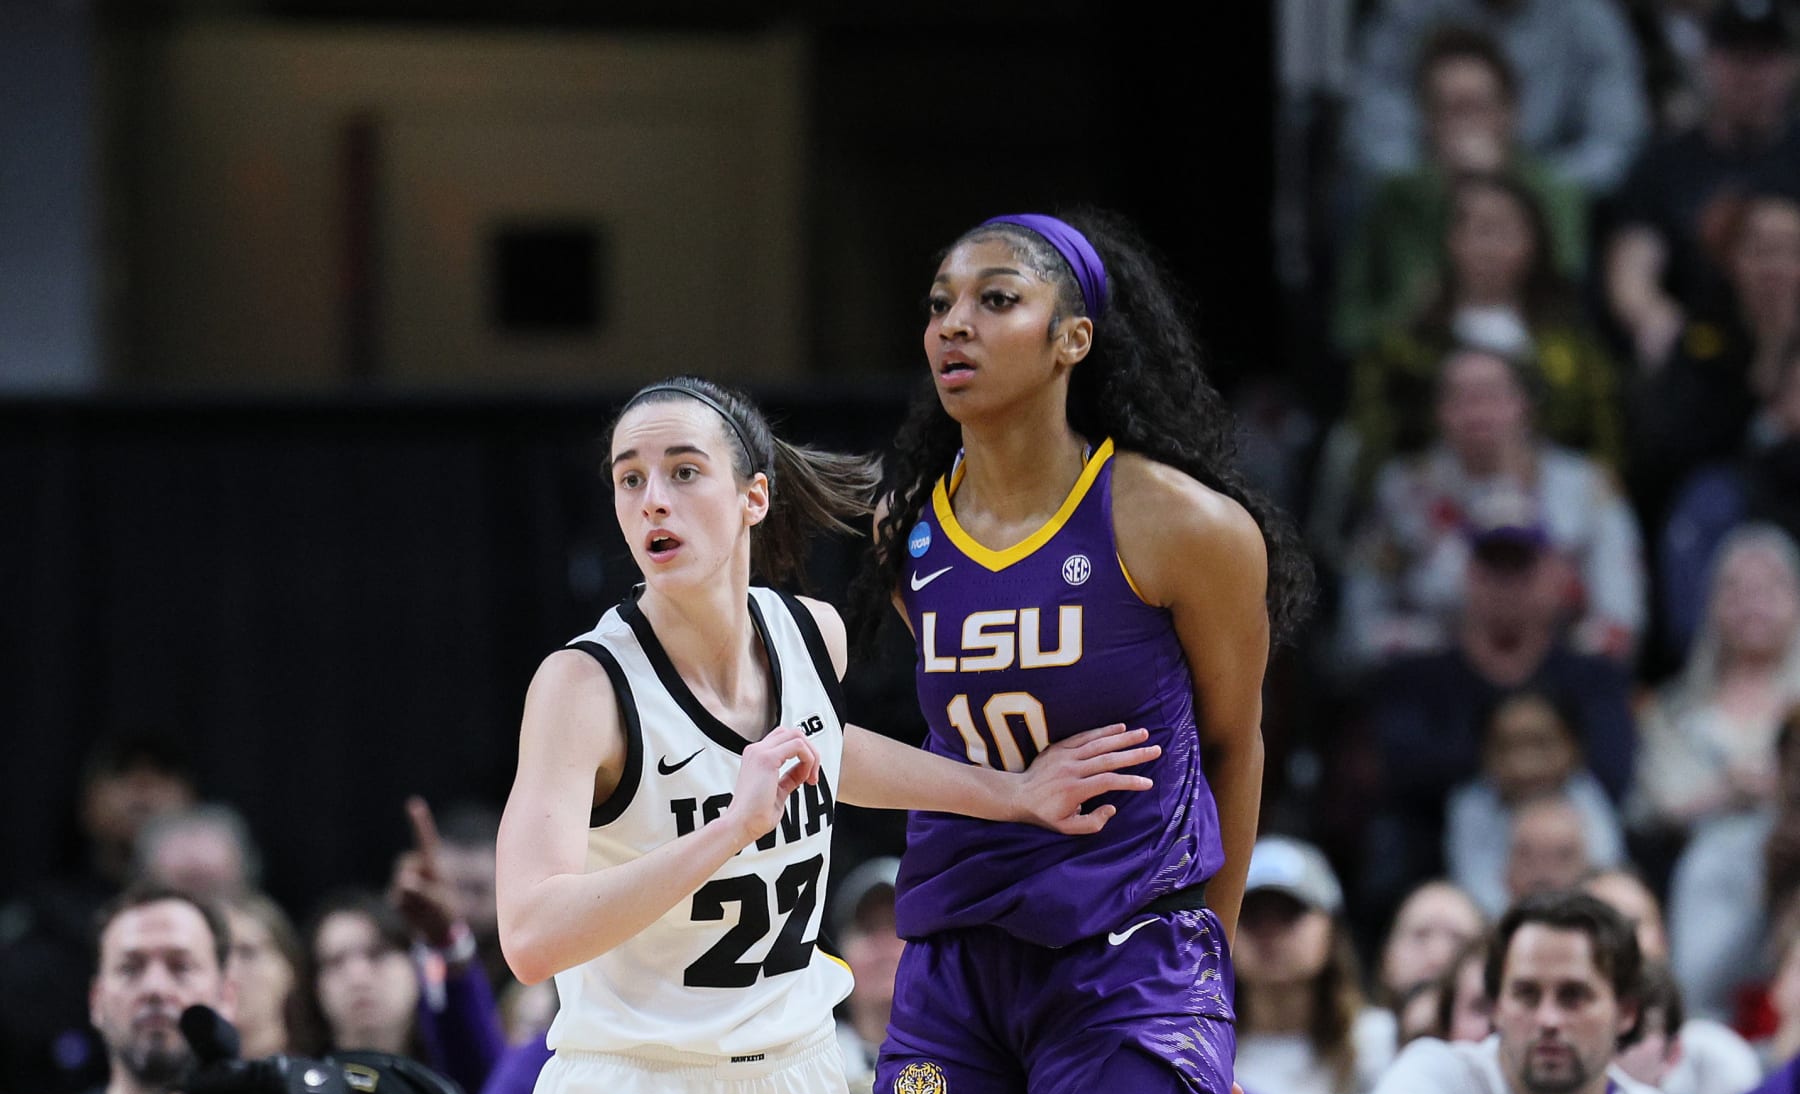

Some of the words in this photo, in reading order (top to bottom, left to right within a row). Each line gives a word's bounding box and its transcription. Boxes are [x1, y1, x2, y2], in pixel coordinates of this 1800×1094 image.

[911, 535, 930, 550] NCAA
[1065, 557, 1088, 582] SEC
[922, 605, 1083, 673] LSU
[797, 715, 824, 737] 1G
[946, 691, 1050, 773] 10
[683, 852, 824, 988] 22
